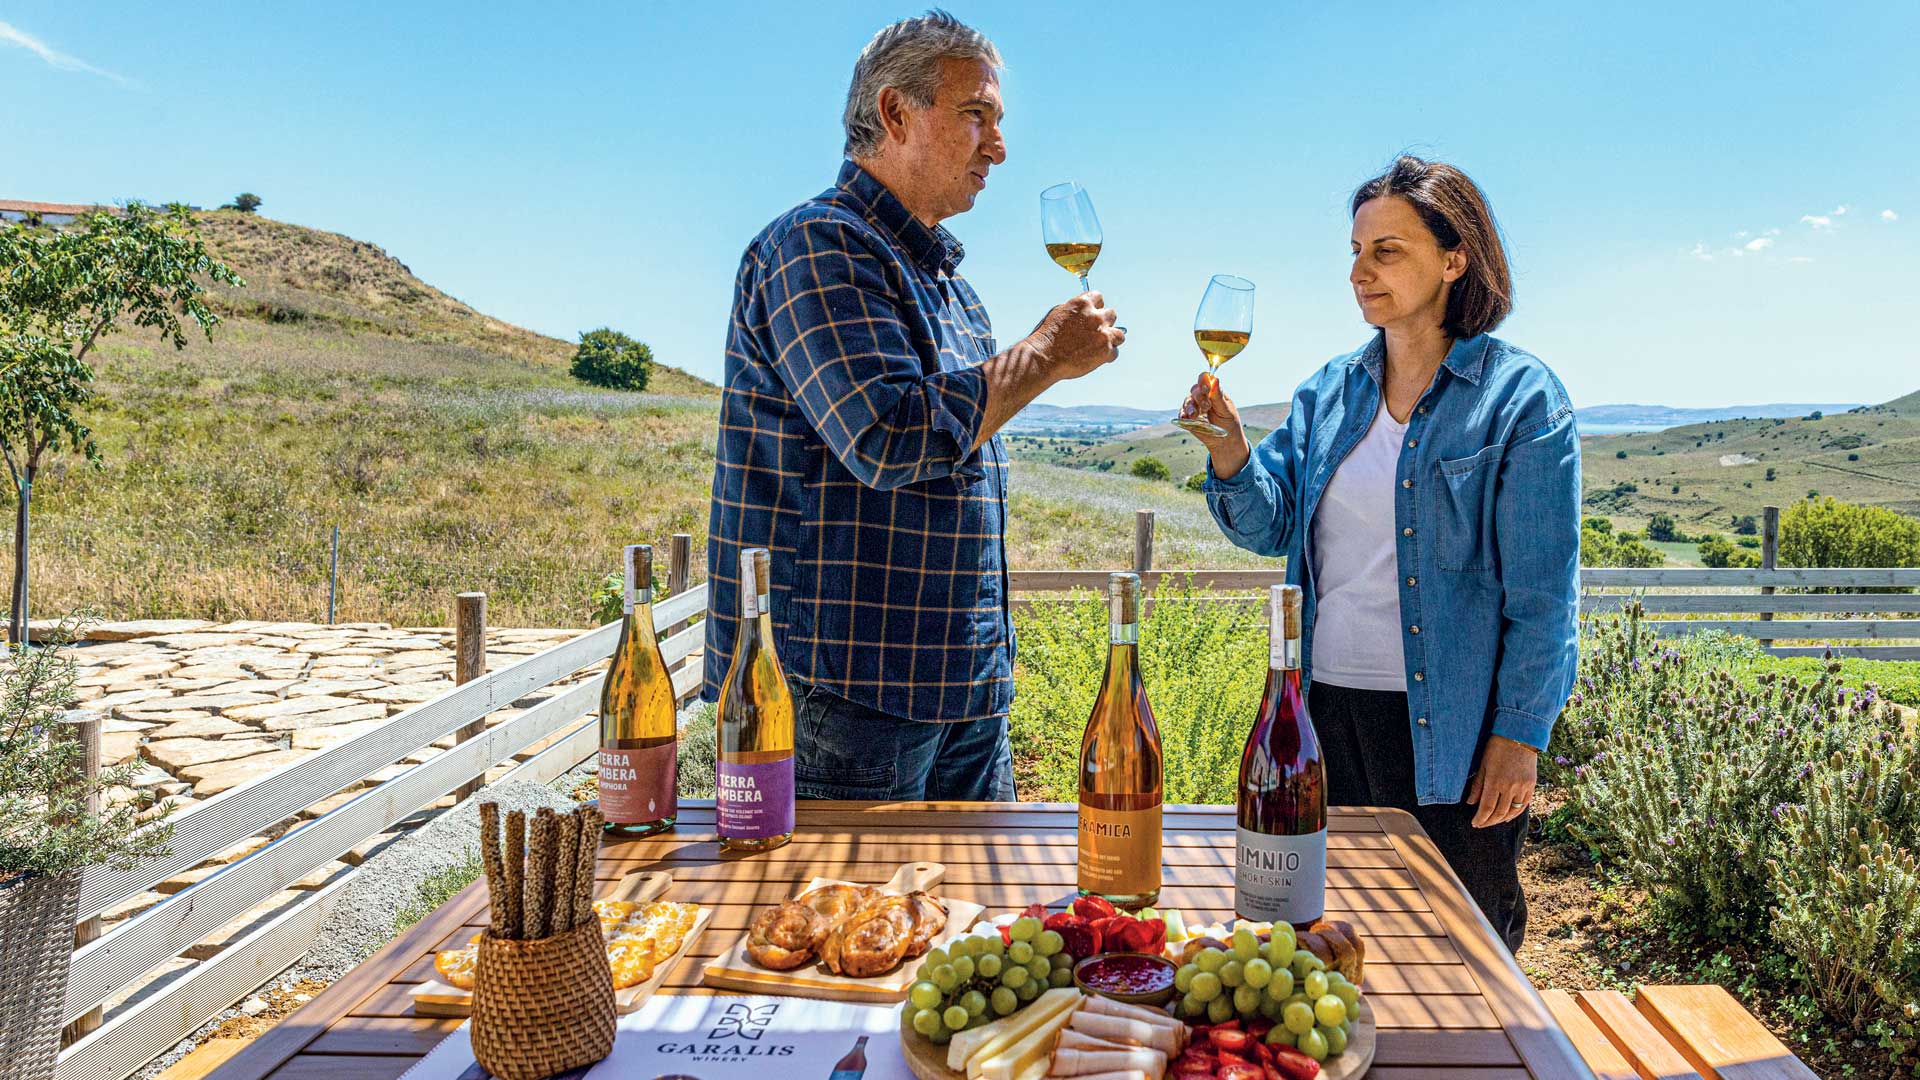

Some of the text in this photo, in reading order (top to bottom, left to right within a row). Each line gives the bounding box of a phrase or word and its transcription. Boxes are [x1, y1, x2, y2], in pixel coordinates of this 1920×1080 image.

[599, 766, 637, 781] MBERA
[720, 774, 755, 789] TERRA
[717, 787, 762, 802] AMBERA
[1078, 815, 1131, 837] ERAMICA
[1268, 877, 1292, 887] SKIN
[657, 1042, 795, 1056] GARALIS
